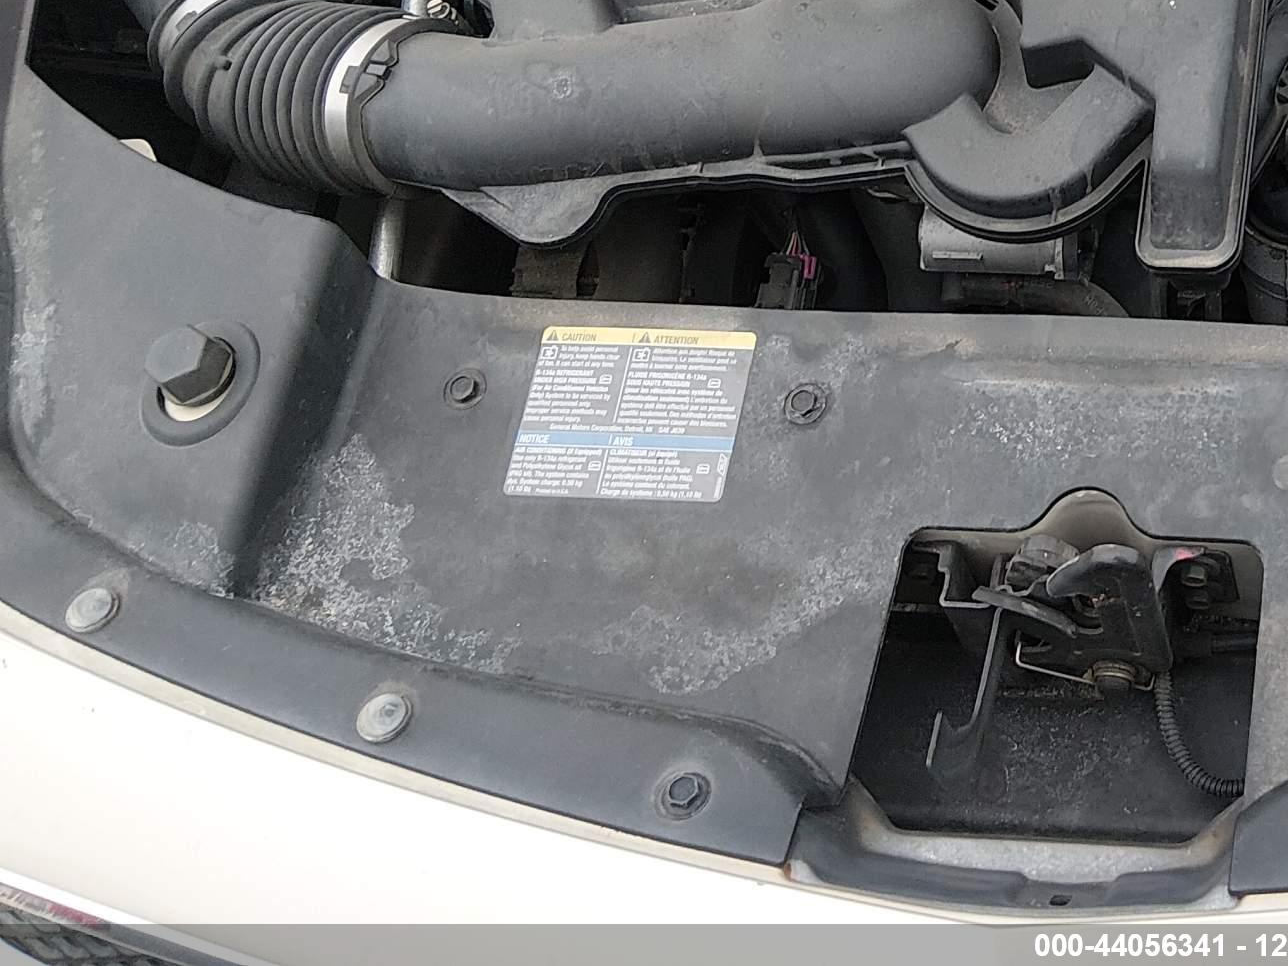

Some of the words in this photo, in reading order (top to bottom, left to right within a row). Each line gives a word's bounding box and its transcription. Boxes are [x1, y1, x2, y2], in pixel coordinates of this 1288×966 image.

[562, 333, 597, 341] CAUTION
[654, 335, 700, 345] ATTENTION
[519, 434, 551, 444] NOTICE
[613, 437, 634, 446] AVIS
